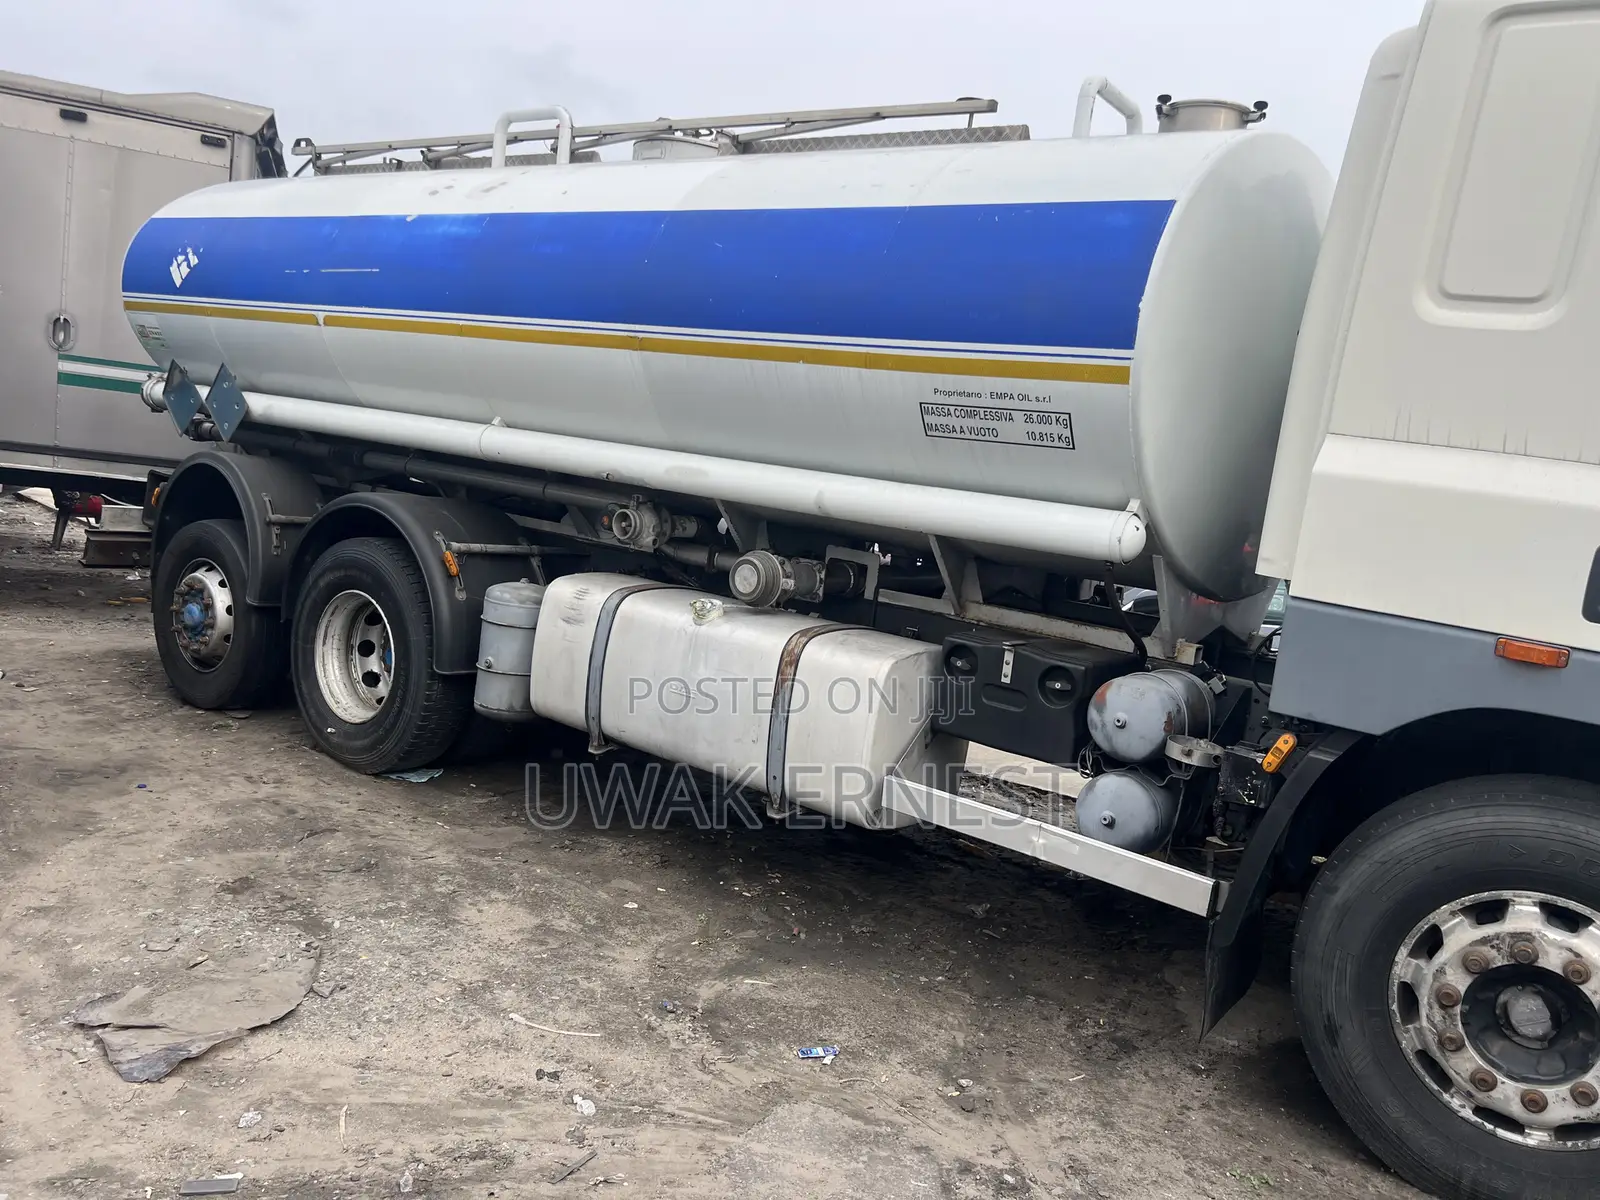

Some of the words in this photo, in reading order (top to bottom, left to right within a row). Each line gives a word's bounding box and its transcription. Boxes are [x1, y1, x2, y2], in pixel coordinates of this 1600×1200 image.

[990, 392, 1015, 401] EMPA
[1017, 394, 1033, 402] OIL
[923, 405, 952, 418] MASSA
[953, 408, 1015, 423] COMPLESSIVA
[1023, 413, 1053, 426] 26.000
[1055, 416, 1069, 429] Kg
[926, 422, 957, 435] MASSA
[959, 425, 966, 436] A
[967, 426, 999, 438] VUOTO
[1026, 431, 1055, 443] 10.815
[1057, 434, 1071, 447] Kg
